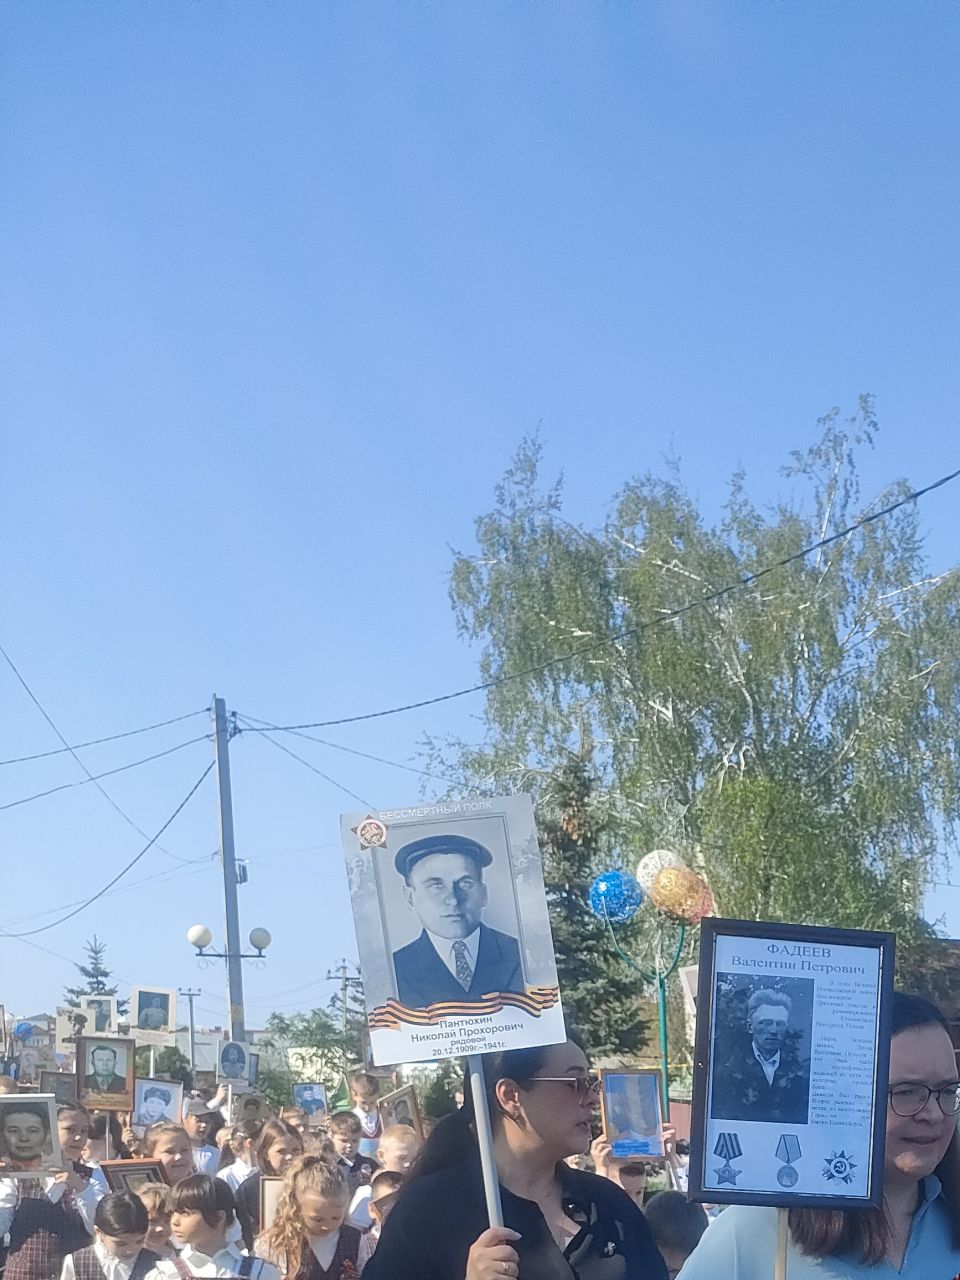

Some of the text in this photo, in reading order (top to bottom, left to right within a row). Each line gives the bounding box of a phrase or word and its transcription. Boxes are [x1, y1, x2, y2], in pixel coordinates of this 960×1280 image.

[379, 800, 493, 821] БЕССМЕРТНЫЙ ПОЛК
[766, 943, 832, 958] ФАДЕЕВ
[731, 955, 865, 975] Валентин Петрович
[439, 1016, 493, 1029] Пантюхин
[410, 1022, 525, 1043] Николай Прохорович
[450, 1035, 487, 1047] рядовой
